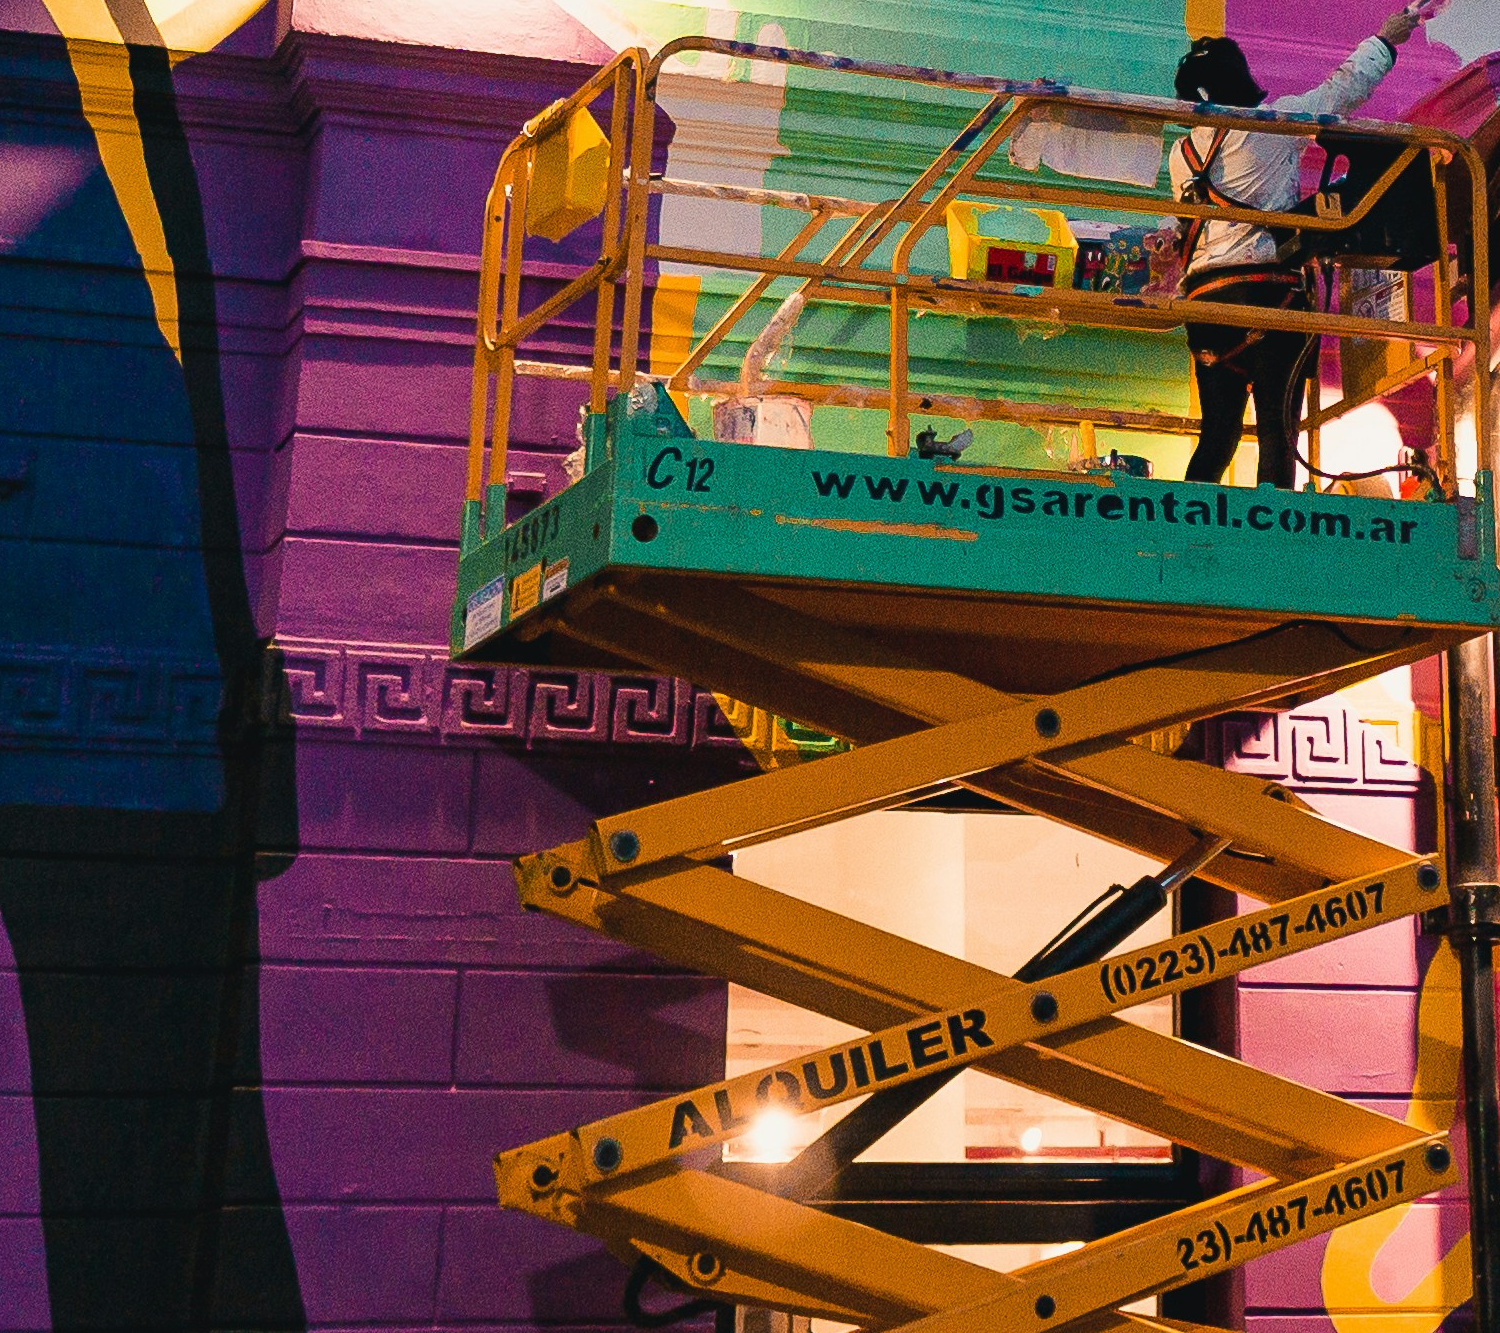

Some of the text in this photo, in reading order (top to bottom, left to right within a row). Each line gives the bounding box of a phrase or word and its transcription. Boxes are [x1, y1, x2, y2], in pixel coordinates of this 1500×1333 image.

[810, 469, 1419, 546] www.gsarental.com.ar
[668, 881, 1386, 1149] ALQUILER (0223)-487-4607
[1176, 1159, 1406, 1270] 23)-487-4607
